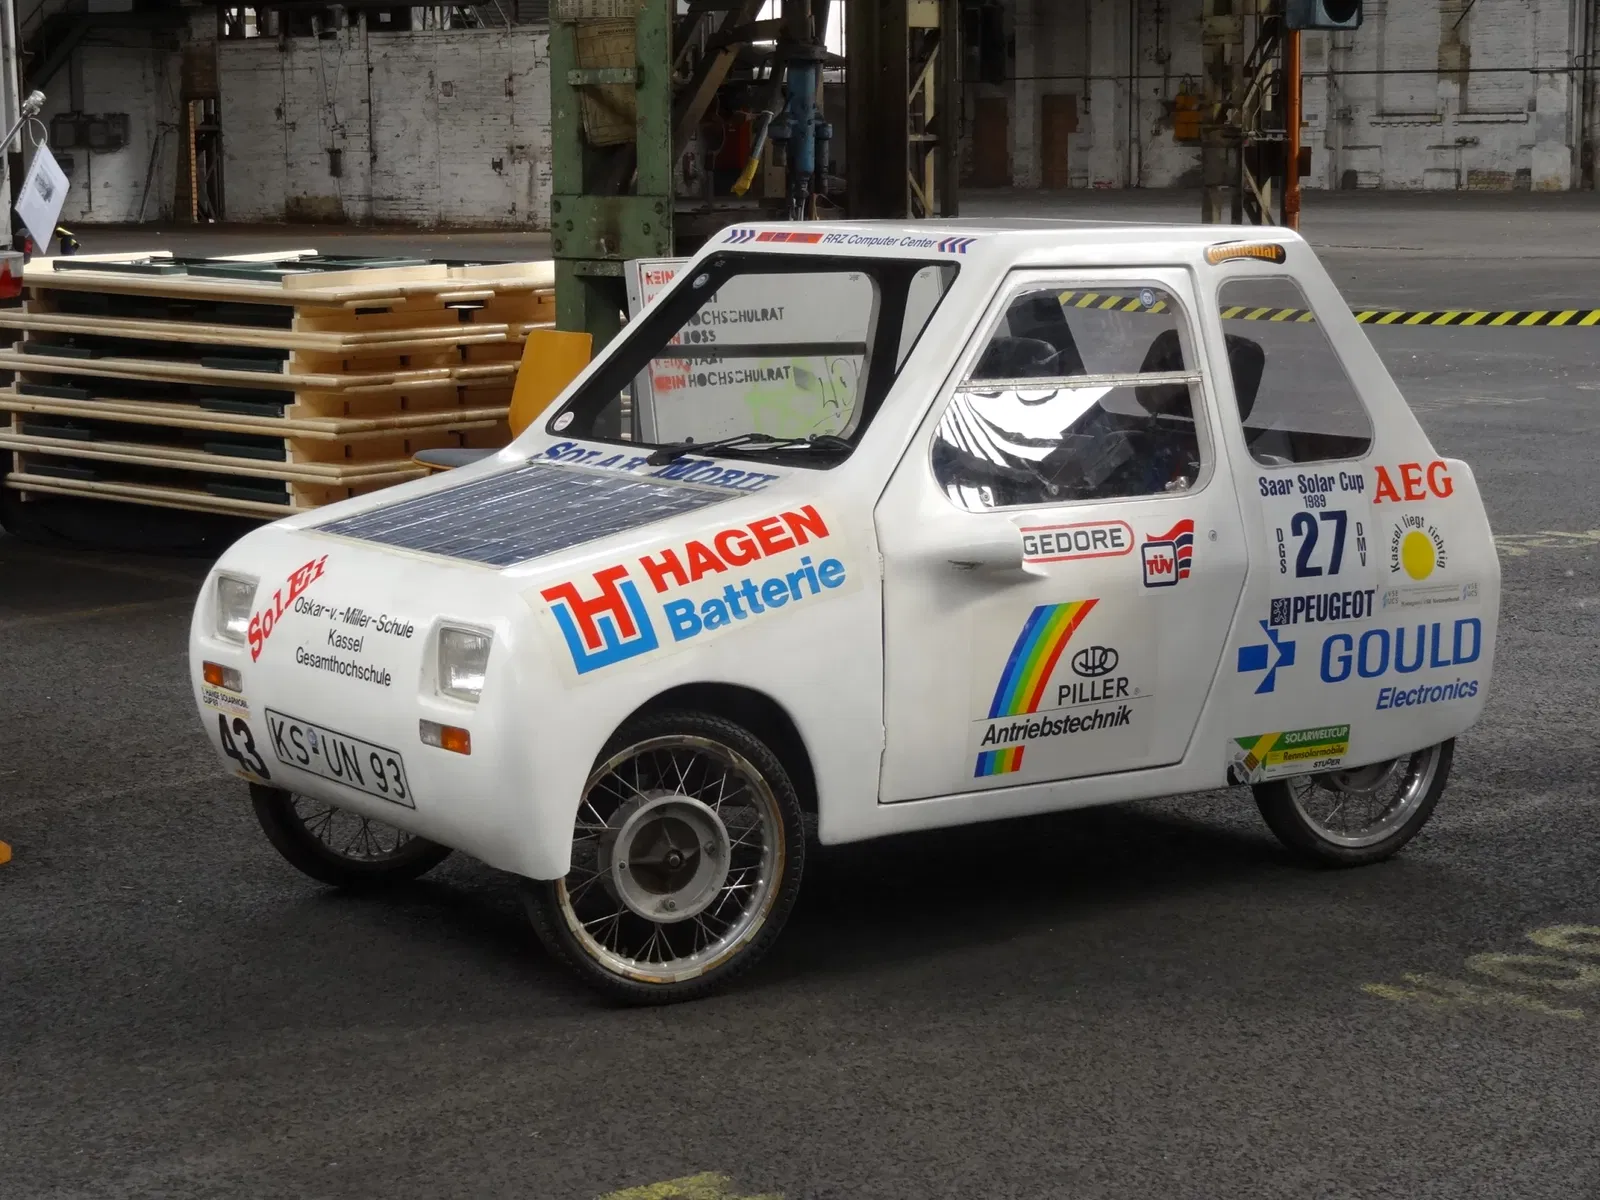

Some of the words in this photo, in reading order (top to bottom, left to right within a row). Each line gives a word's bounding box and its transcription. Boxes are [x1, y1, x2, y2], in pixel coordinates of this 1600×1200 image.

[822, 233, 850, 244] RRZ
[847, 234, 900, 248] Computer
[900, 236, 938, 248] Center
[645, 270, 675, 285] KEIN
[687, 307, 785, 327] OCHSCHULRAT
[683, 329, 717, 344] BOSS
[1258, 476, 1294, 497] Saar
[1297, 473, 1336, 495] Solar
[1339, 471, 1365, 494] Cup
[1373, 461, 1454, 504] AEG
[1303, 495, 1327, 509] 1989
[638, 504, 830, 594] HAGEN
[1022, 527, 1125, 556] GEDORE
[1291, 510, 1348, 579] 27
[1390, 523, 1404, 573] Kassel
[1401, 514, 1425, 529] liegt
[1427, 525, 1446, 569] richtig
[1146, 555, 1174, 576] TÜV
[663, 555, 846, 643] Batterie
[1292, 589, 1376, 625] PEUGEOT
[328, 628, 364, 653] Kassel
[1319, 617, 1482, 684] GOULD
[295, 646, 392, 687] Gesamthochschule
[1057, 676, 1130, 706] PILLER
[1375, 677, 1479, 710] Electronics
[980, 704, 1133, 747] Antriebstechnik
[1284, 726, 1348, 744] SOLARWELTCUP
[218, 713, 271, 780] 43
[1282, 744, 1345, 760] Rennsolarmobile
[369, 752, 406, 799] 93
[1312, 758, 1341, 768] STUDER
